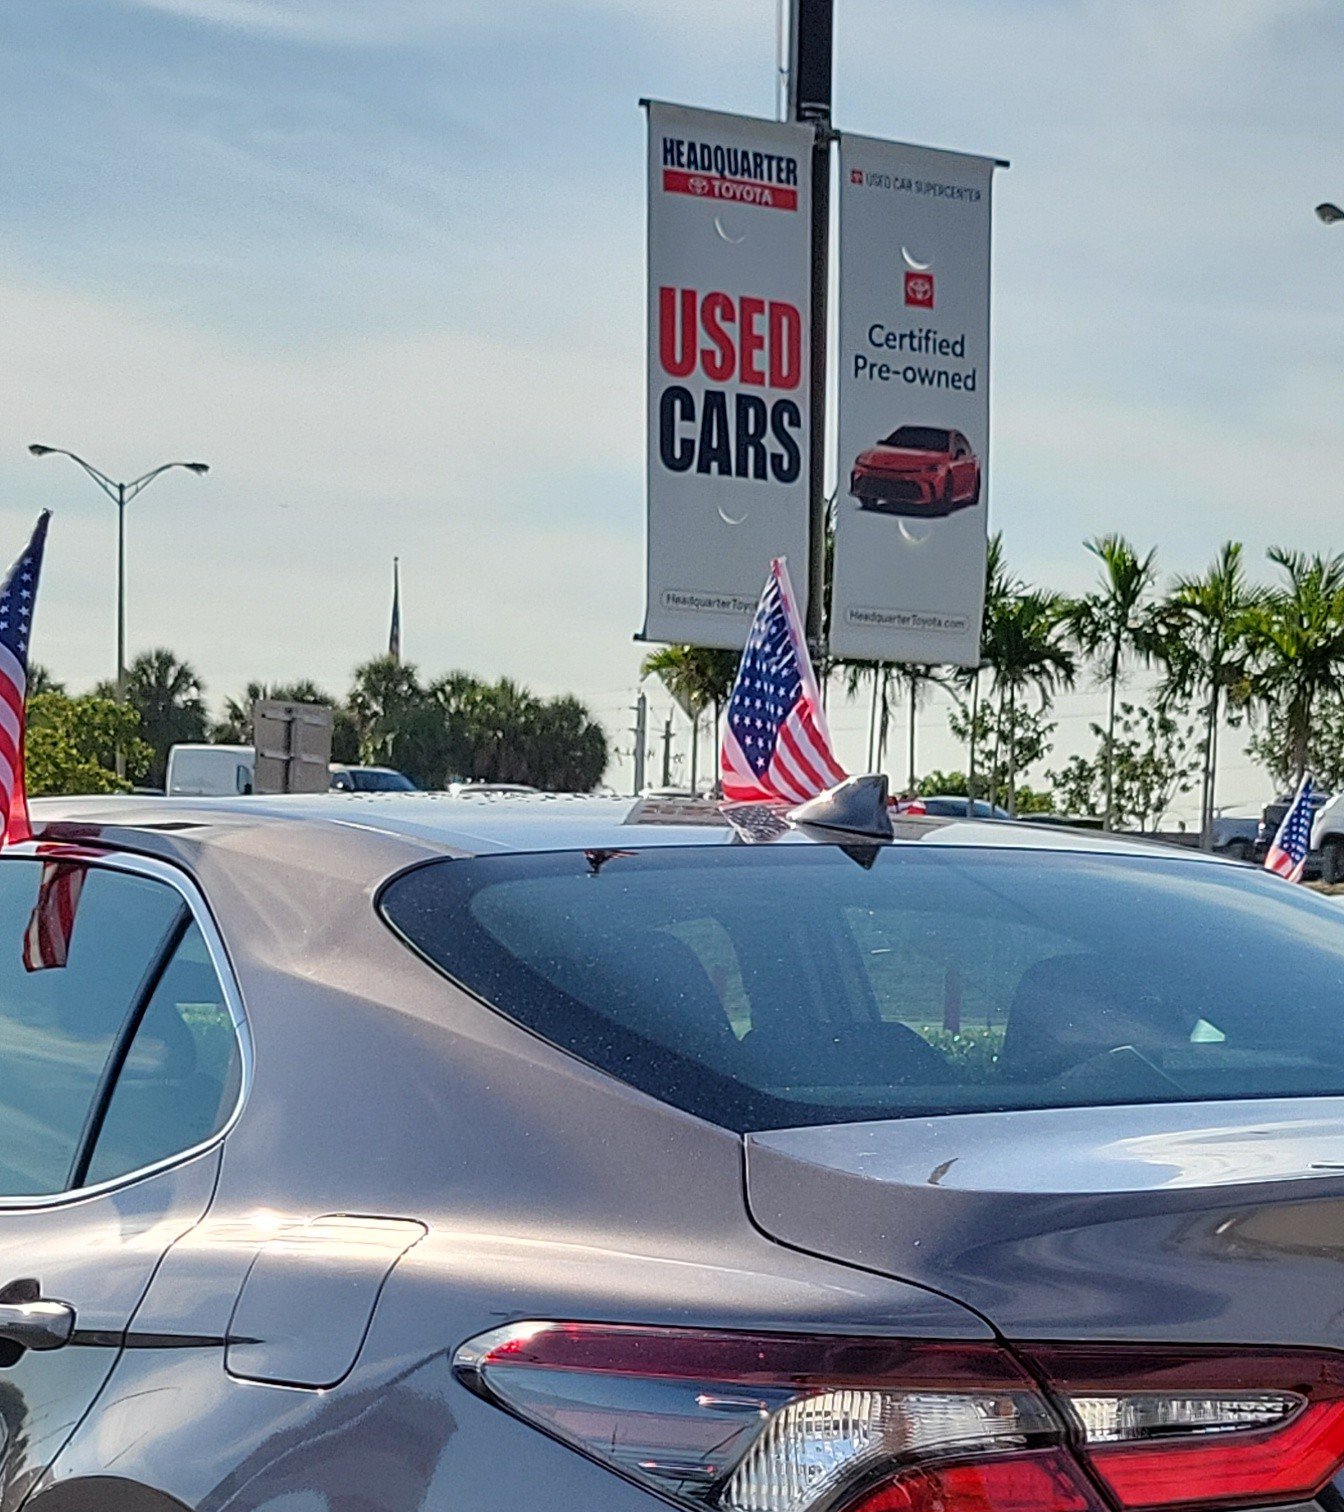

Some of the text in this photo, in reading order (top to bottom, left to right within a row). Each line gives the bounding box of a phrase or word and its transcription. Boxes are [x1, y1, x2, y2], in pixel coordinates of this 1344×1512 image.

[662, 137, 798, 187] HEADQUARTER
[711, 179, 773, 206] TOYOTA
[893, 177, 913, 192] CAR
[658, 285, 802, 391] USED
[867, 323, 965, 359] Certified
[853, 354, 977, 392] Pre-owned
[659, 384, 802, 483] CARS
